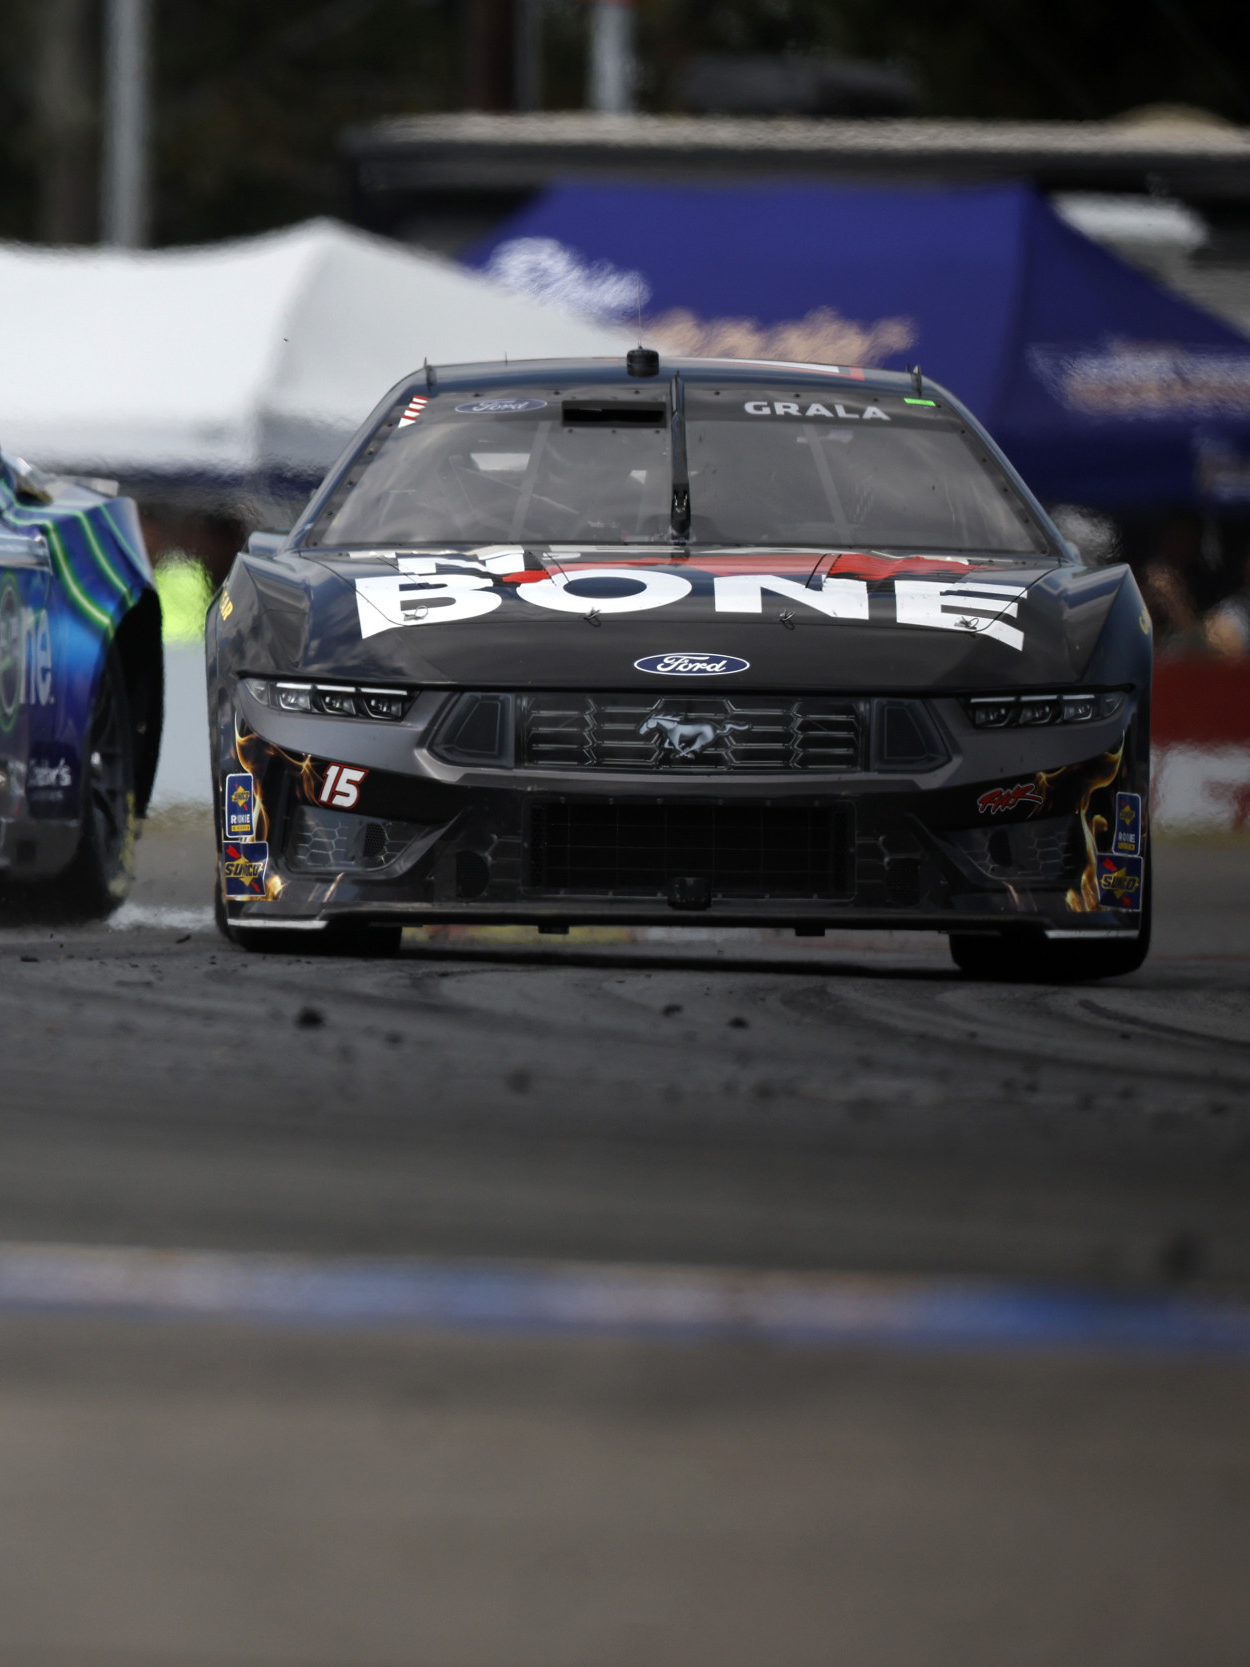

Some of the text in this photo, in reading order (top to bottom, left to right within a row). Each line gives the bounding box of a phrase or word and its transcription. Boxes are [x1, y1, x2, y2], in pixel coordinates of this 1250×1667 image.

[744, 401, 891, 421] GRALA
[355, 568, 1027, 652] BONE
[656, 655, 727, 672] Ford
[318, 762, 369, 810] 15
